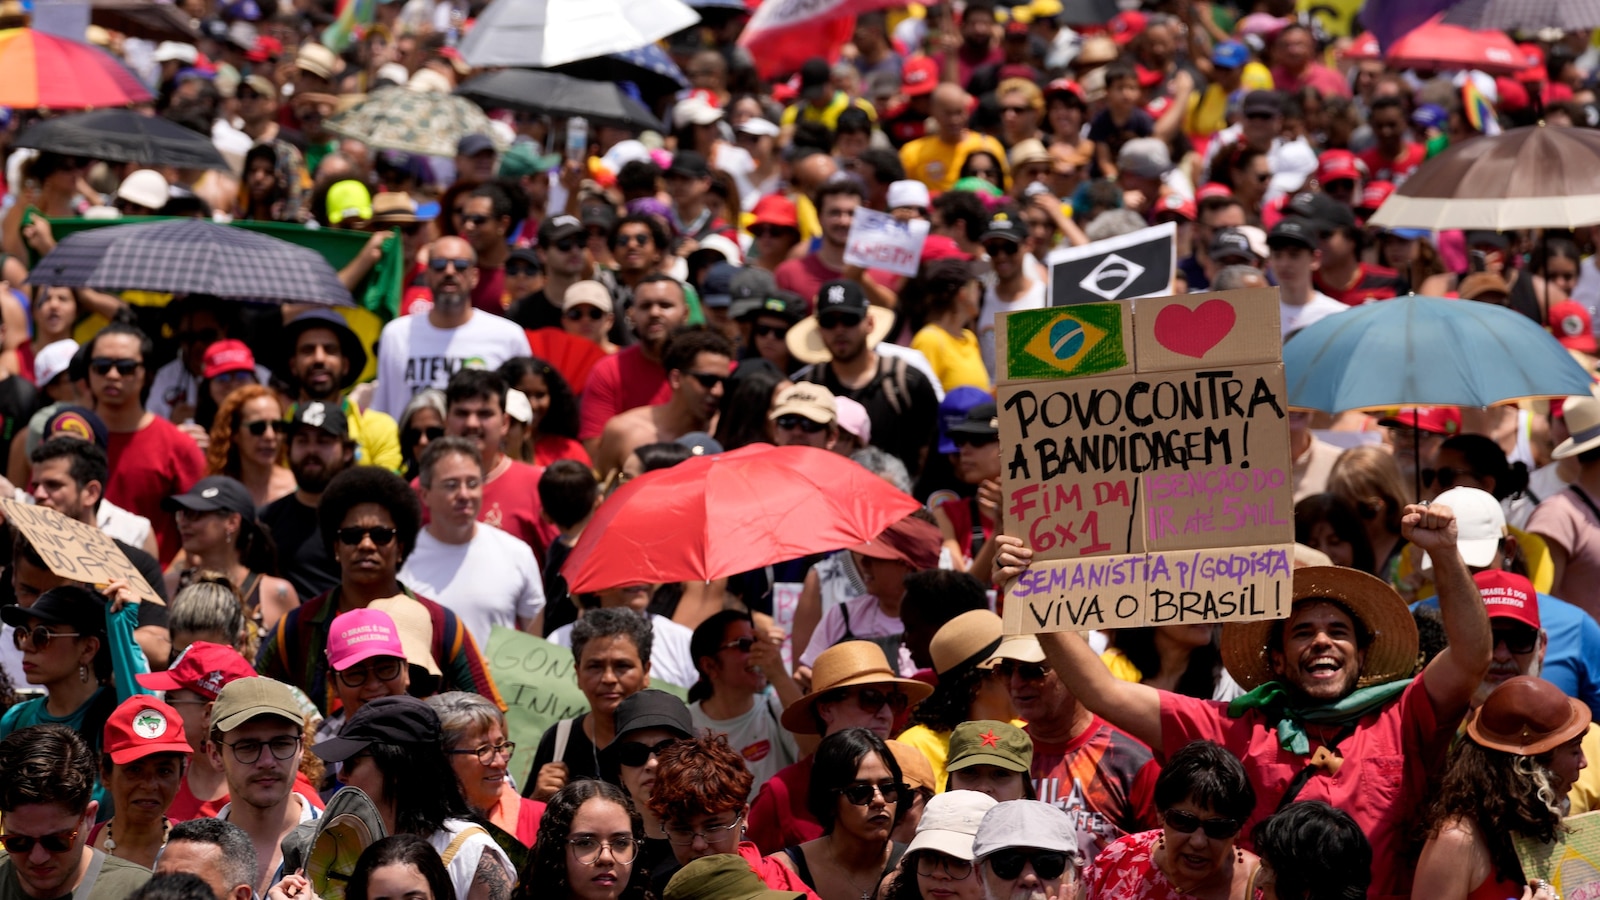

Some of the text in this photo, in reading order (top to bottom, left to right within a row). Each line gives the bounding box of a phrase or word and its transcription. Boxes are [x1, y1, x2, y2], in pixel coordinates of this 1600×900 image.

[1008, 443, 1031, 480] A
[1252, 467, 1286, 493] DO
[1009, 480, 1130, 522] FIM DA
[1149, 505, 1178, 540] IR
[1029, 595, 1104, 628] VIVA
[1115, 595, 1139, 619] O
